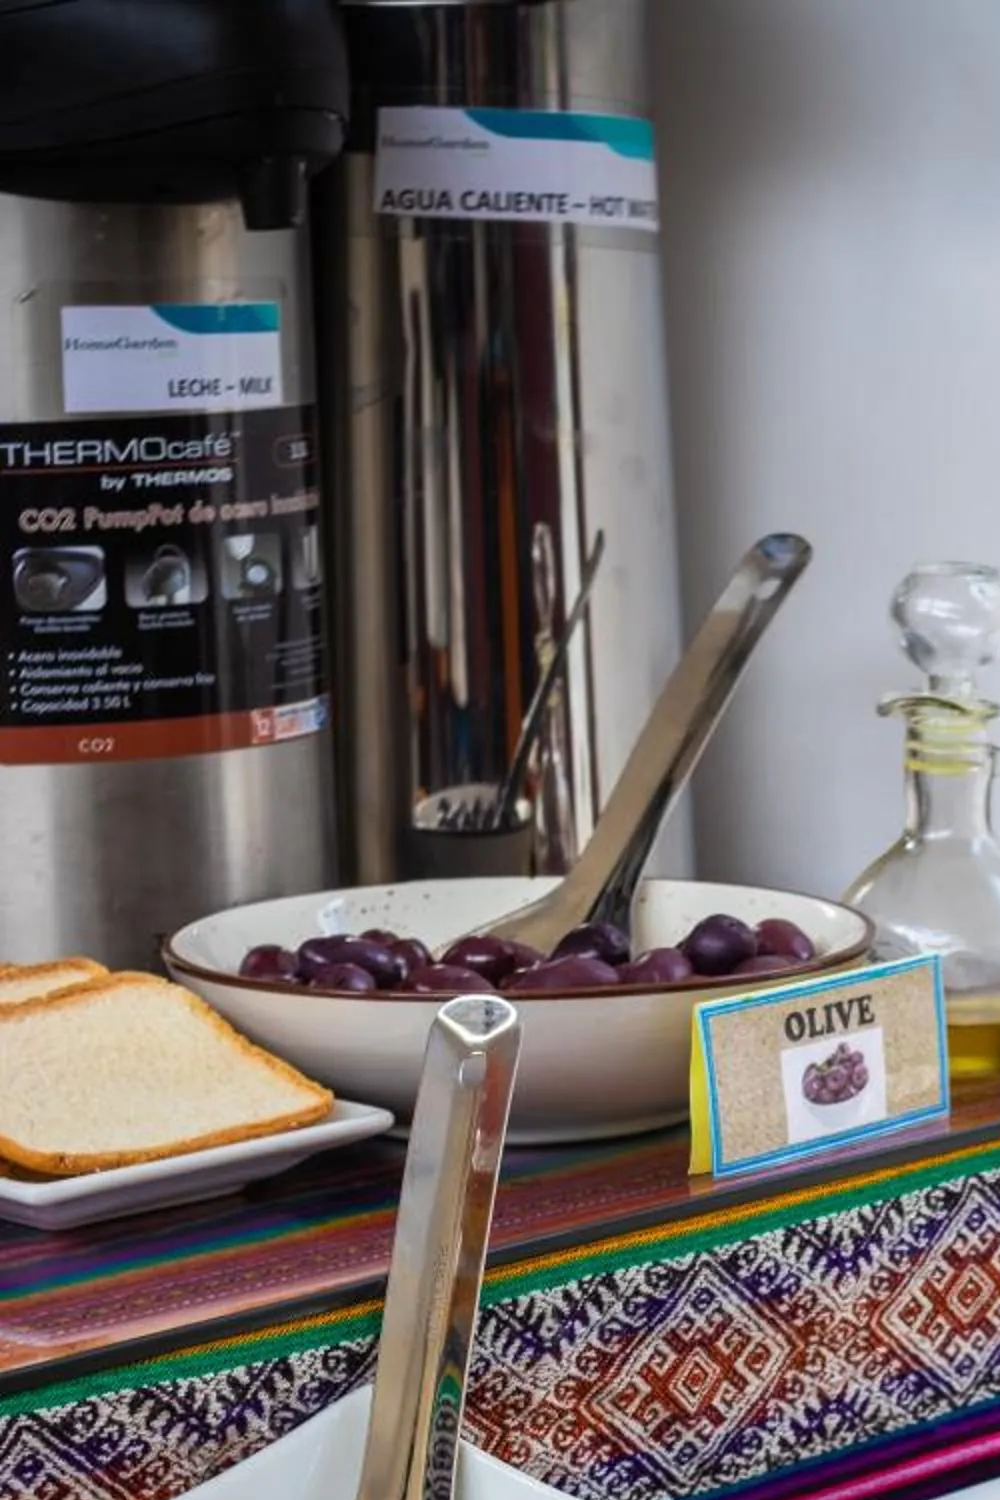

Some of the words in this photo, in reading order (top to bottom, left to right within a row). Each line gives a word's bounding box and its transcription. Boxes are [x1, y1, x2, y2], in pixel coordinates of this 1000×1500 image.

[381, 189, 453, 211] AGUA
[459, 190, 570, 214] CALIENTE
[589, 196, 625, 217] HOT
[167, 378, 221, 399] LECHE
[0, 433, 232, 467] THERMOcafé
[100, 474, 127, 491] by
[131, 467, 233, 488] THERMOS
[18, 508, 77, 533] CO2
[83, 503, 185, 533] PumpPot
[188, 500, 217, 524] de
[78, 737, 116, 754] CO2
[783, 994, 876, 1042] OLIVE
